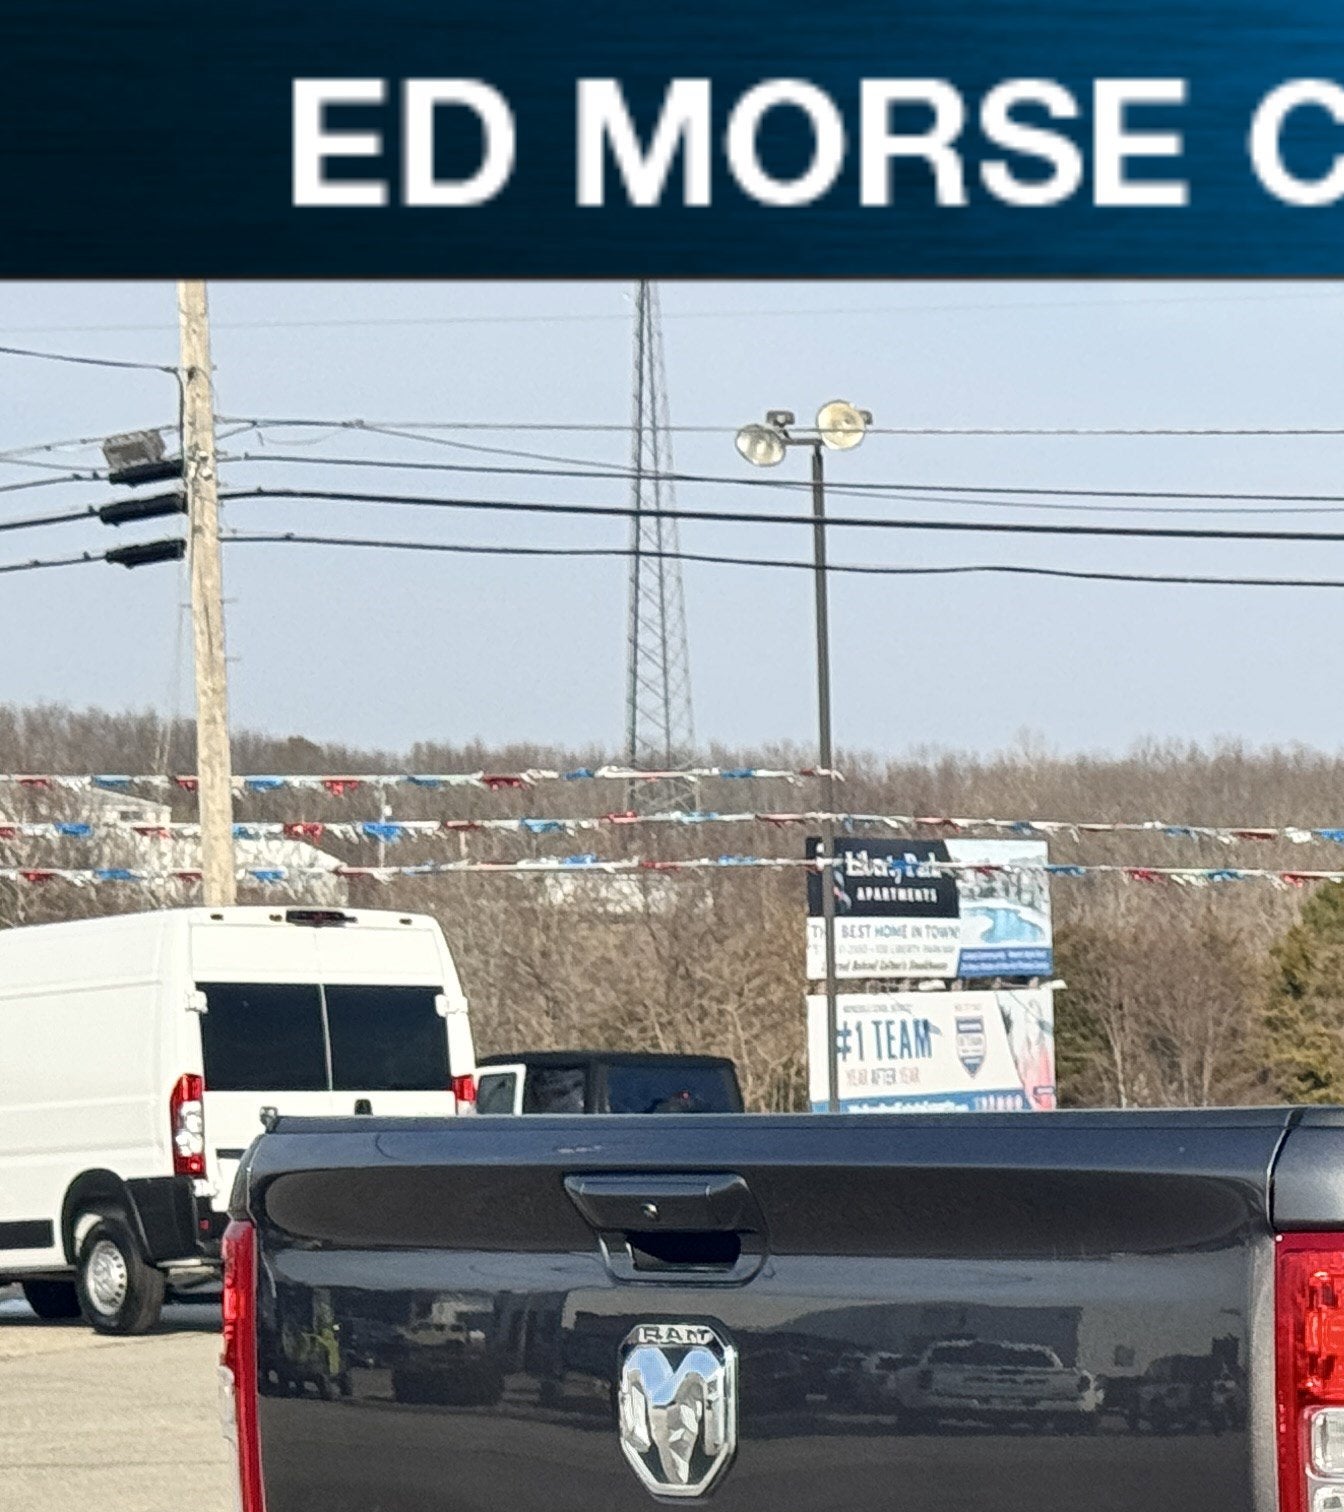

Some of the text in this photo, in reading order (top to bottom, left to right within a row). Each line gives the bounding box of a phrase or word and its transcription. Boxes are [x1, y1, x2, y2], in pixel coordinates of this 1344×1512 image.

[842, 925, 871, 940] BEST
[875, 925, 907, 940] HOME
[911, 925, 923, 940] IN
[873, 1018, 933, 1061] TEAM
